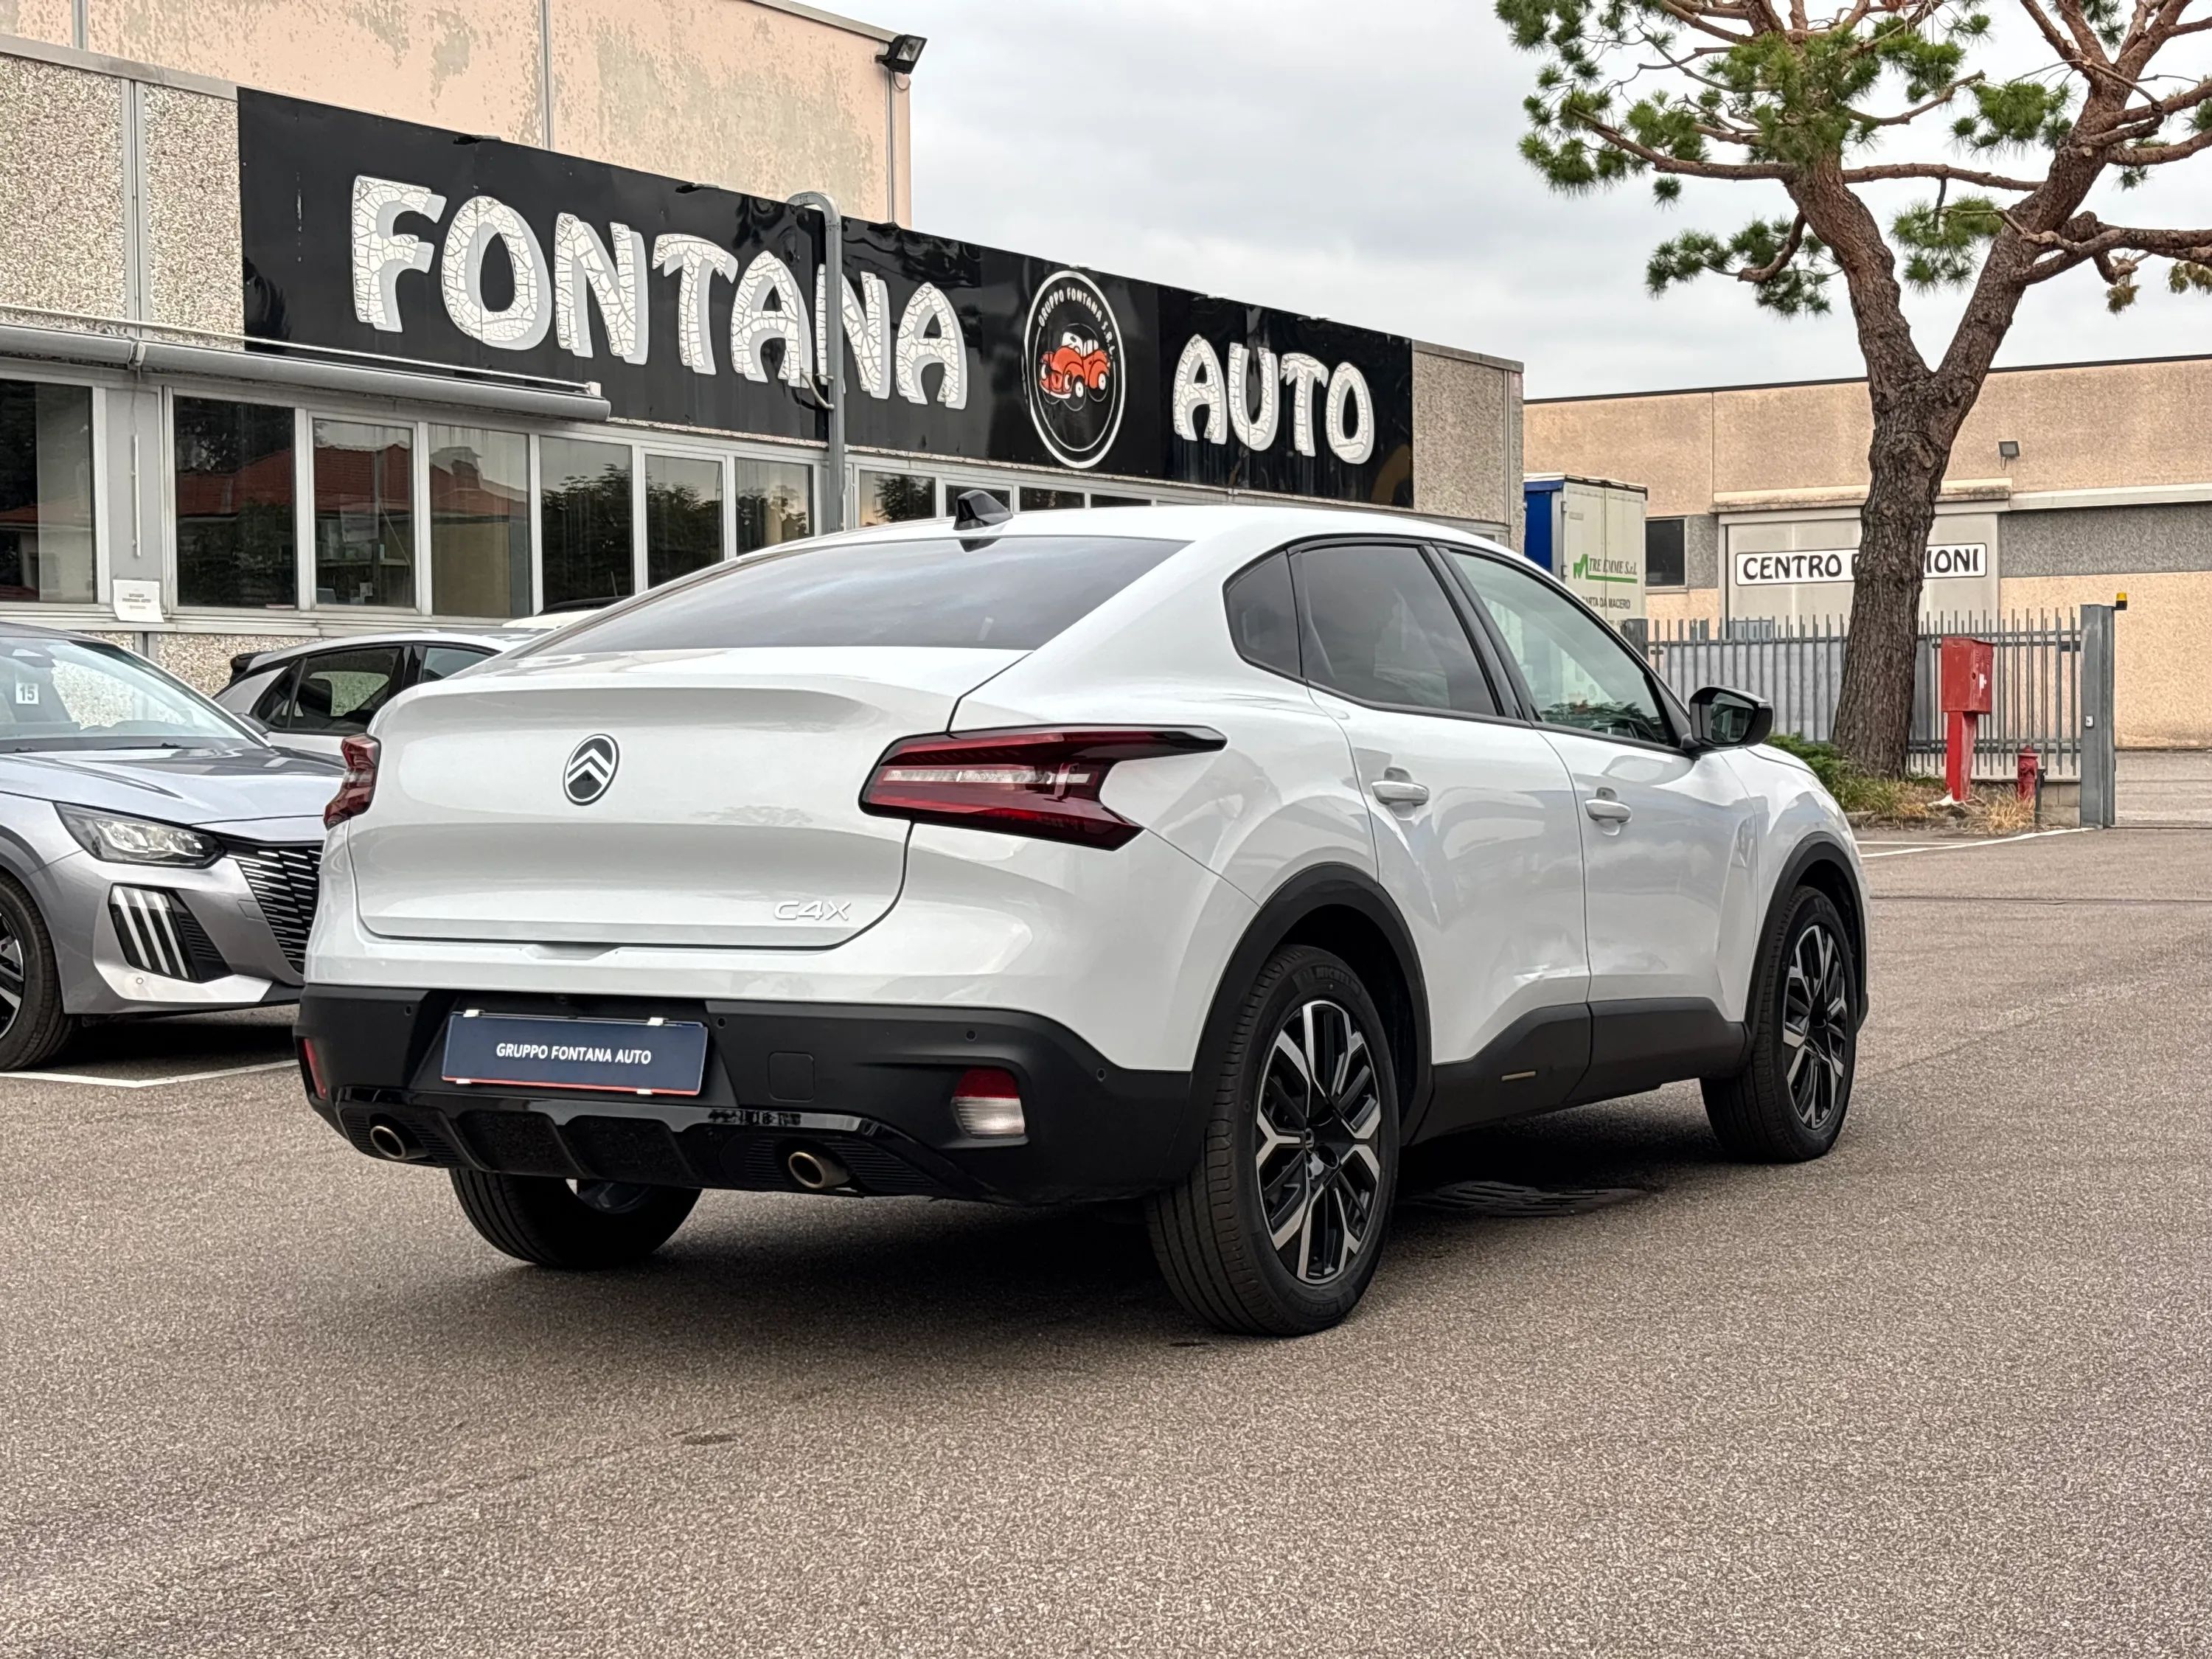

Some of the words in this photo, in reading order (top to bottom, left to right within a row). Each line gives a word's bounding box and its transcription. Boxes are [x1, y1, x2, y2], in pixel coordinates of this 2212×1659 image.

[1038, 289, 1064, 327] GRUPPO
[1066, 286, 1102, 322] FONTANA
[351, 174, 968, 410] FONTANA
[1173, 334, 1374, 465] AUTO
[1589, 557, 1601, 572] TRE
[1603, 560, 1623, 574] EMME
[1743, 554, 1842, 580] CENTRO
[20, 685, 35, 701] 15
[496, 1043, 549, 1059] GRUPPO
[551, 1046, 612, 1063] FONTANA
[615, 1050, 652, 1065] AUTO
